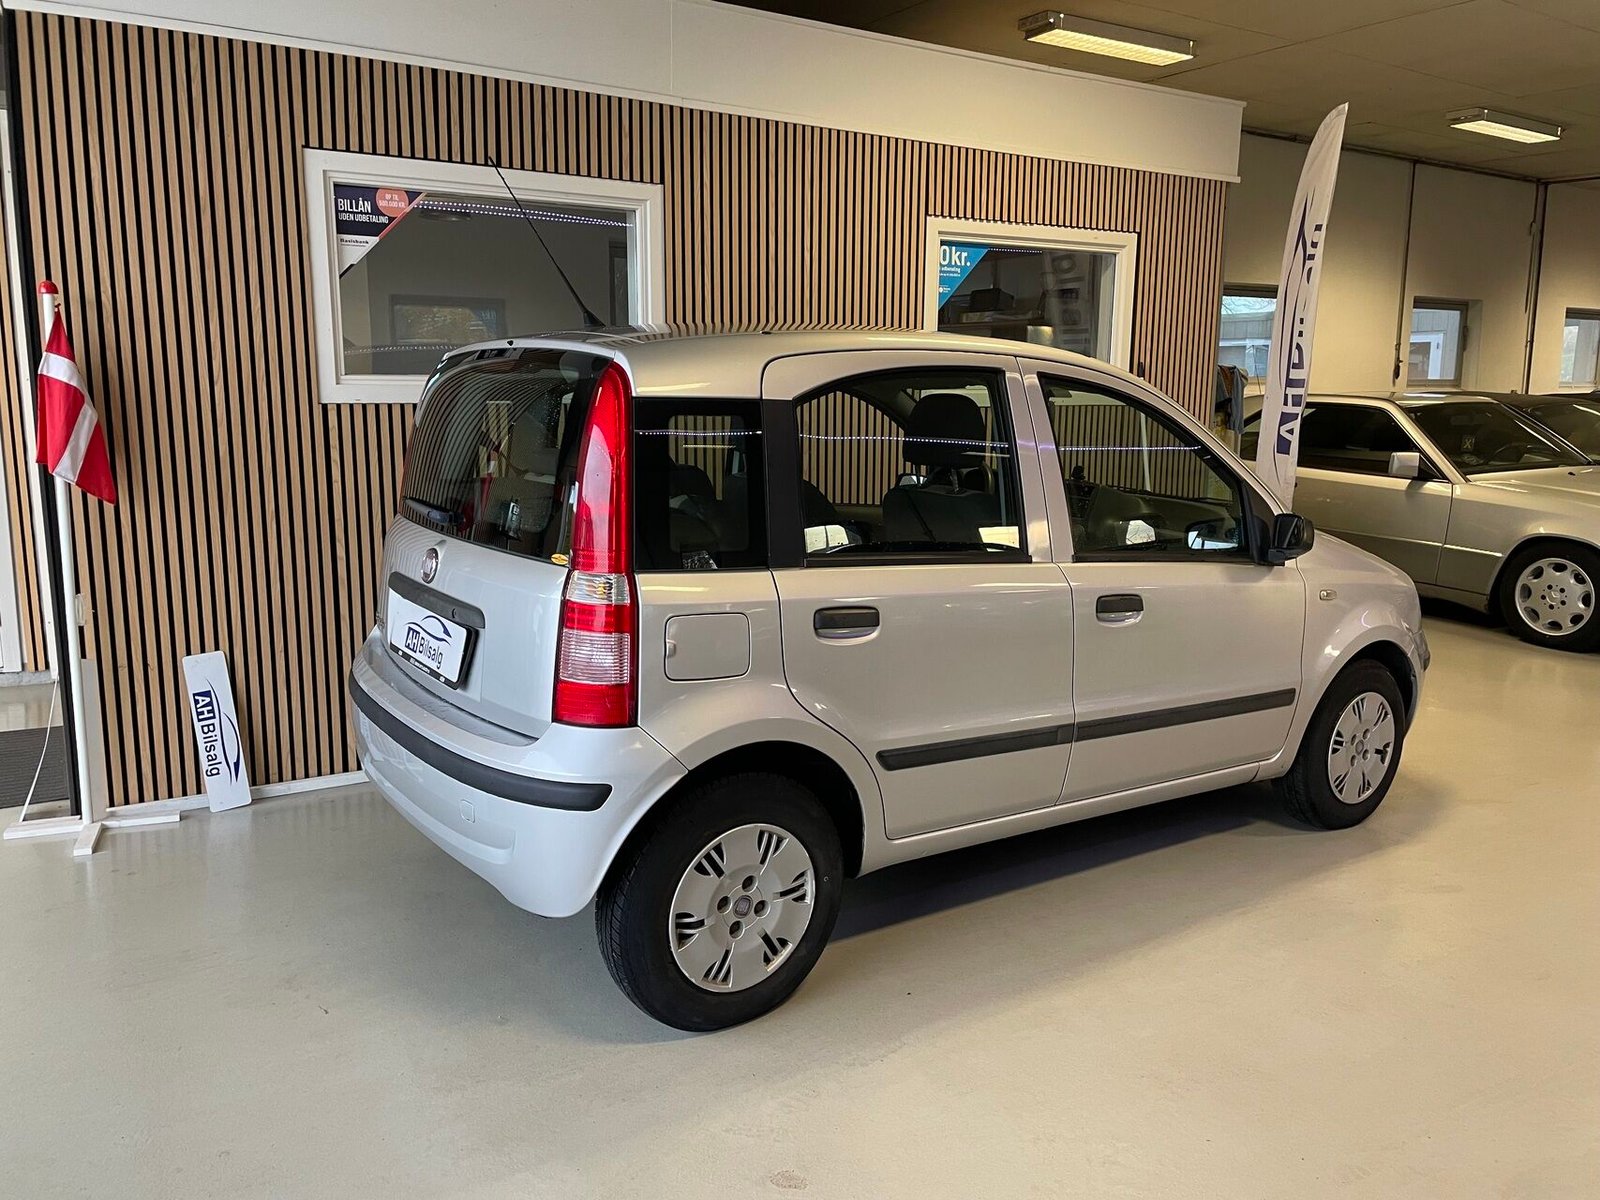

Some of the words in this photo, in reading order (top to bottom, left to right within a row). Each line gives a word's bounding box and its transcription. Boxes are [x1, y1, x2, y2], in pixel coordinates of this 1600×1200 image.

[337, 198, 371, 213] BILLÅN
[338, 213, 354, 221] UDEN
[354, 213, 389, 224] UDBETALING
[405, 627, 420, 653] AH
[418, 635, 444, 670] Bilsalg
[194, 691, 215, 721] AH
[201, 722, 222, 778] Bilsalg
